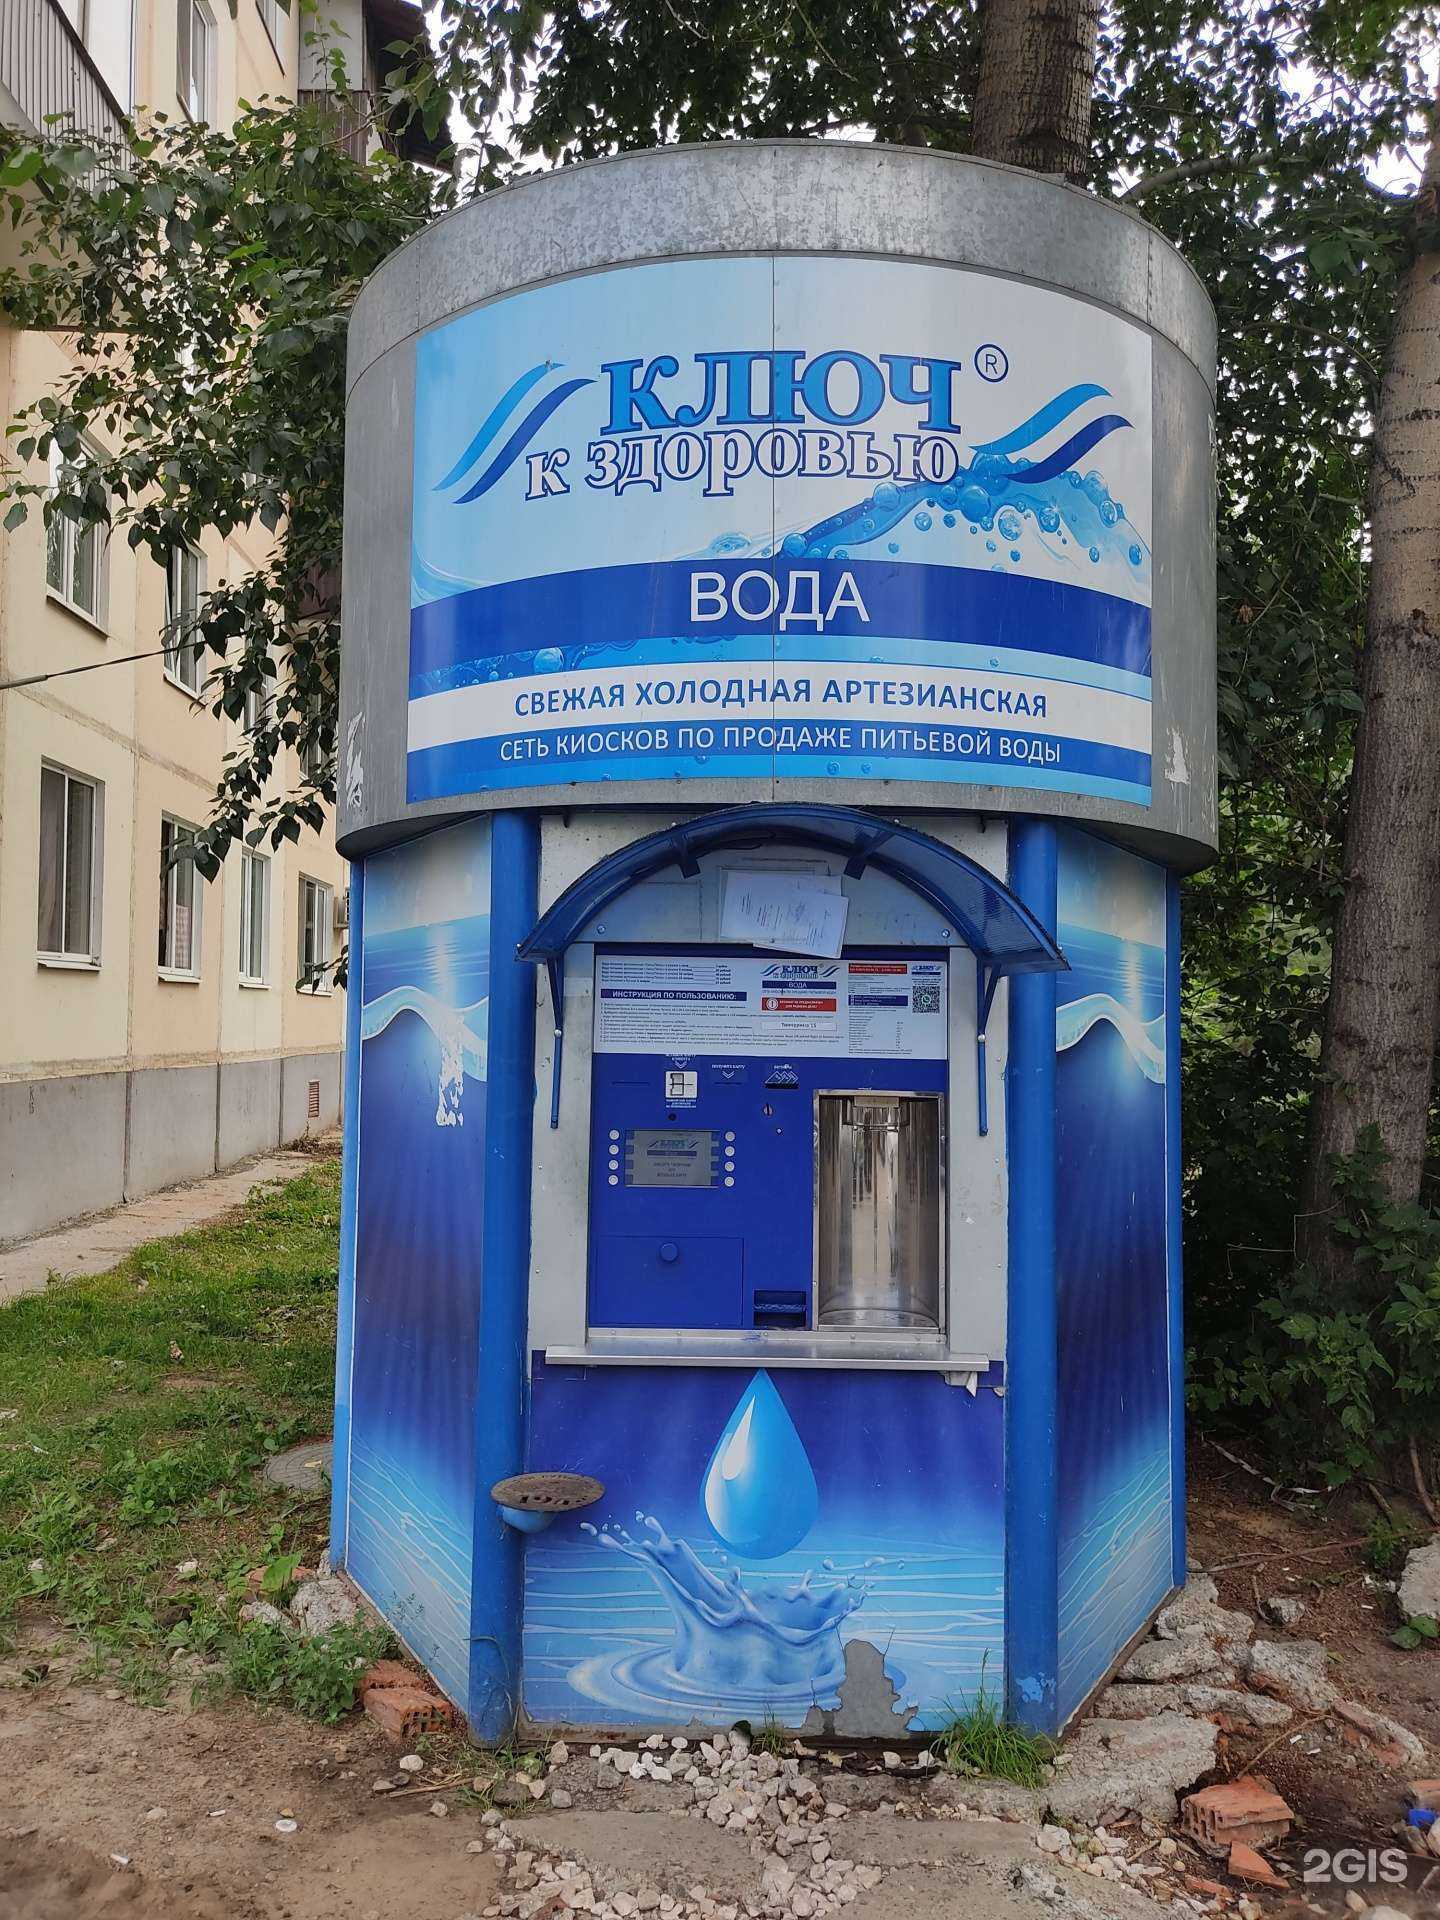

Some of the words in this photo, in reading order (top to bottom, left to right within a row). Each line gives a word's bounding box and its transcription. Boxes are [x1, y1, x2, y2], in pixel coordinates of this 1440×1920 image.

[600, 350, 961, 436] КЛЮЧ
[690, 571, 870, 632] ВОДА
[514, 684, 625, 716] СВЕЖАЯ
[635, 679, 811, 708] ХОЛОДНАЯ
[822, 679, 1047, 718] АРТЕЗИАНСКАЯ
[500, 737, 549, 761] СЕТЬ
[556, 729, 669, 756] КИОСКОВ
[678, 727, 714, 749] ПО
[724, 726, 851, 752] ПРОДАЖЕ
[861, 728, 991, 756] ПИТЬЕВОЙ
[999, 738, 1061, 764] ВОДЫ
[612, 990, 662, 999] ИНСТРУКЦИЯ
[663, 991, 675, 999] ПО
[788, 981, 808, 989] ВОДА
